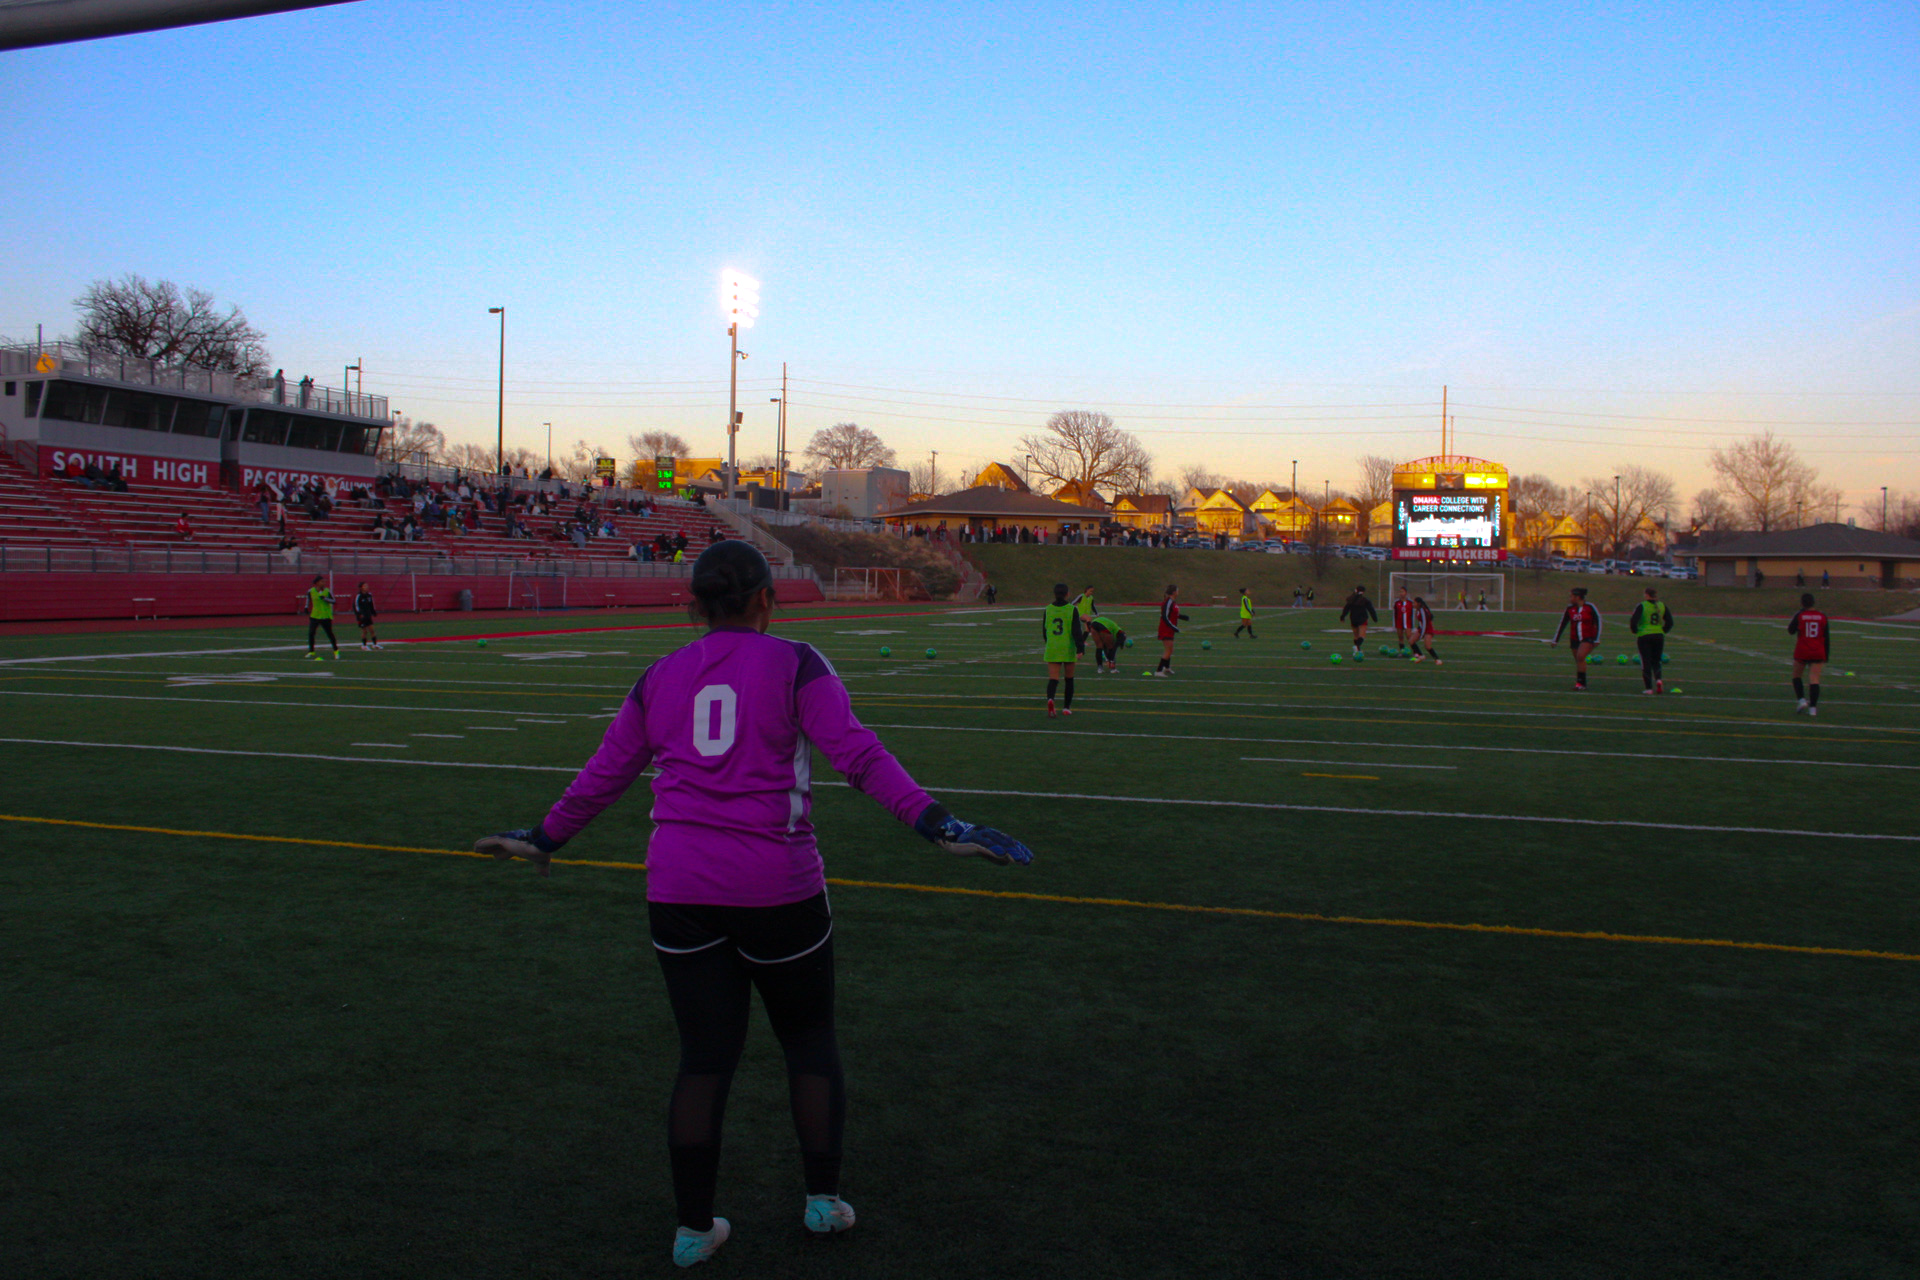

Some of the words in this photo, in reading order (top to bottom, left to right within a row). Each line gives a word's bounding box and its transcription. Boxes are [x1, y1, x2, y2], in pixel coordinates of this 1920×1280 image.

[153, 460, 208, 484] HIGH
[243, 468, 319, 491] PACKERS
[1413, 496, 1440, 504] OMAHA:
[1441, 496, 1470, 504] COLLEGE
[1470, 496, 1488, 504] WITH
[1439, 505, 1485, 513] CONNECTIONS
[1400, 550, 1419, 558] HOME
[1422, 550, 1431, 558] OF
[1432, 550, 1446, 558] THE
[1448, 549, 1499, 560] PACKERS
[1053, 618, 1064, 635] 3
[1650, 613, 1659, 625] 8
[1805, 621, 1819, 638] 18
[693, 684, 737, 757] 0
